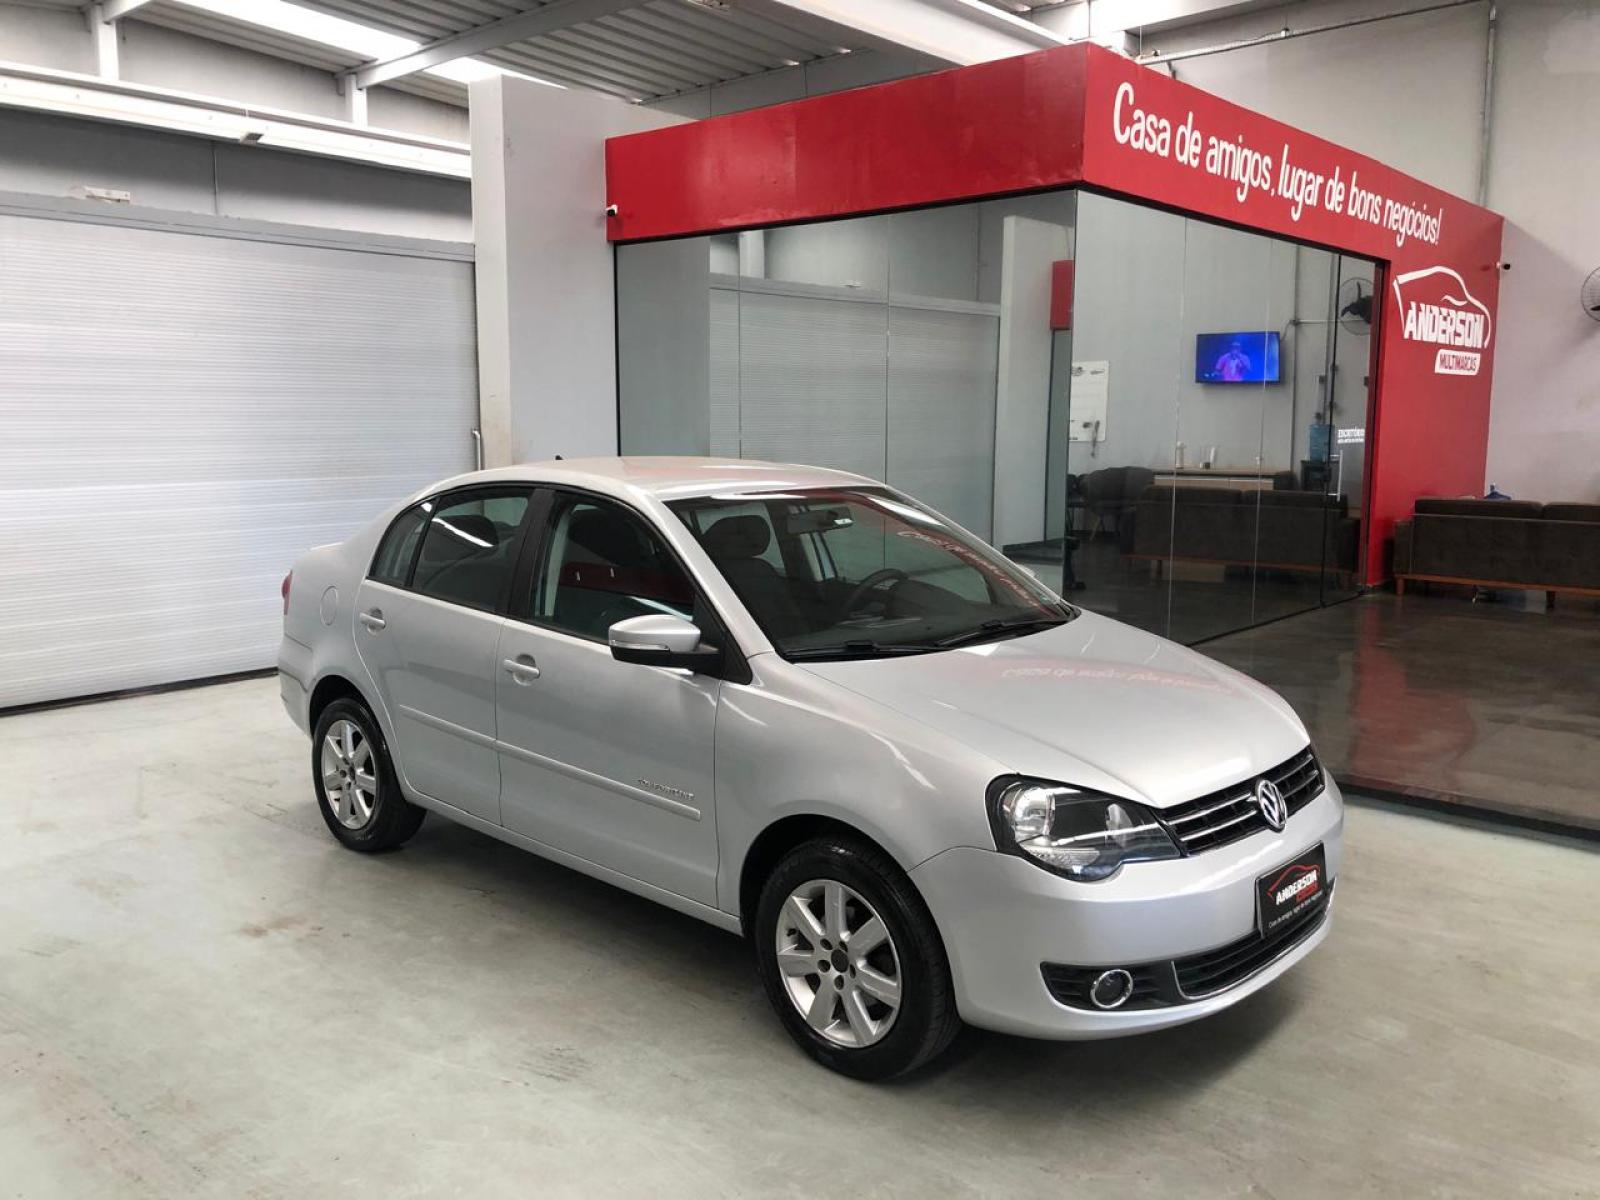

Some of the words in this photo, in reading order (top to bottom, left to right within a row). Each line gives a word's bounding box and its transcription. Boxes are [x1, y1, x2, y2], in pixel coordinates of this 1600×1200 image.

[1113, 82, 1171, 157] Casa
[1175, 111, 1201, 168] de
[1277, 144, 1324, 221] lugar
[1324, 166, 1345, 214] de
[1347, 171, 1382, 225] bons
[1383, 200, 1442, 247] negócios!
[1404, 301, 1485, 348] ANDERSON
[1439, 353, 1477, 371] MULTIMARCAS
[1276, 870, 1317, 905] ANDERSON
